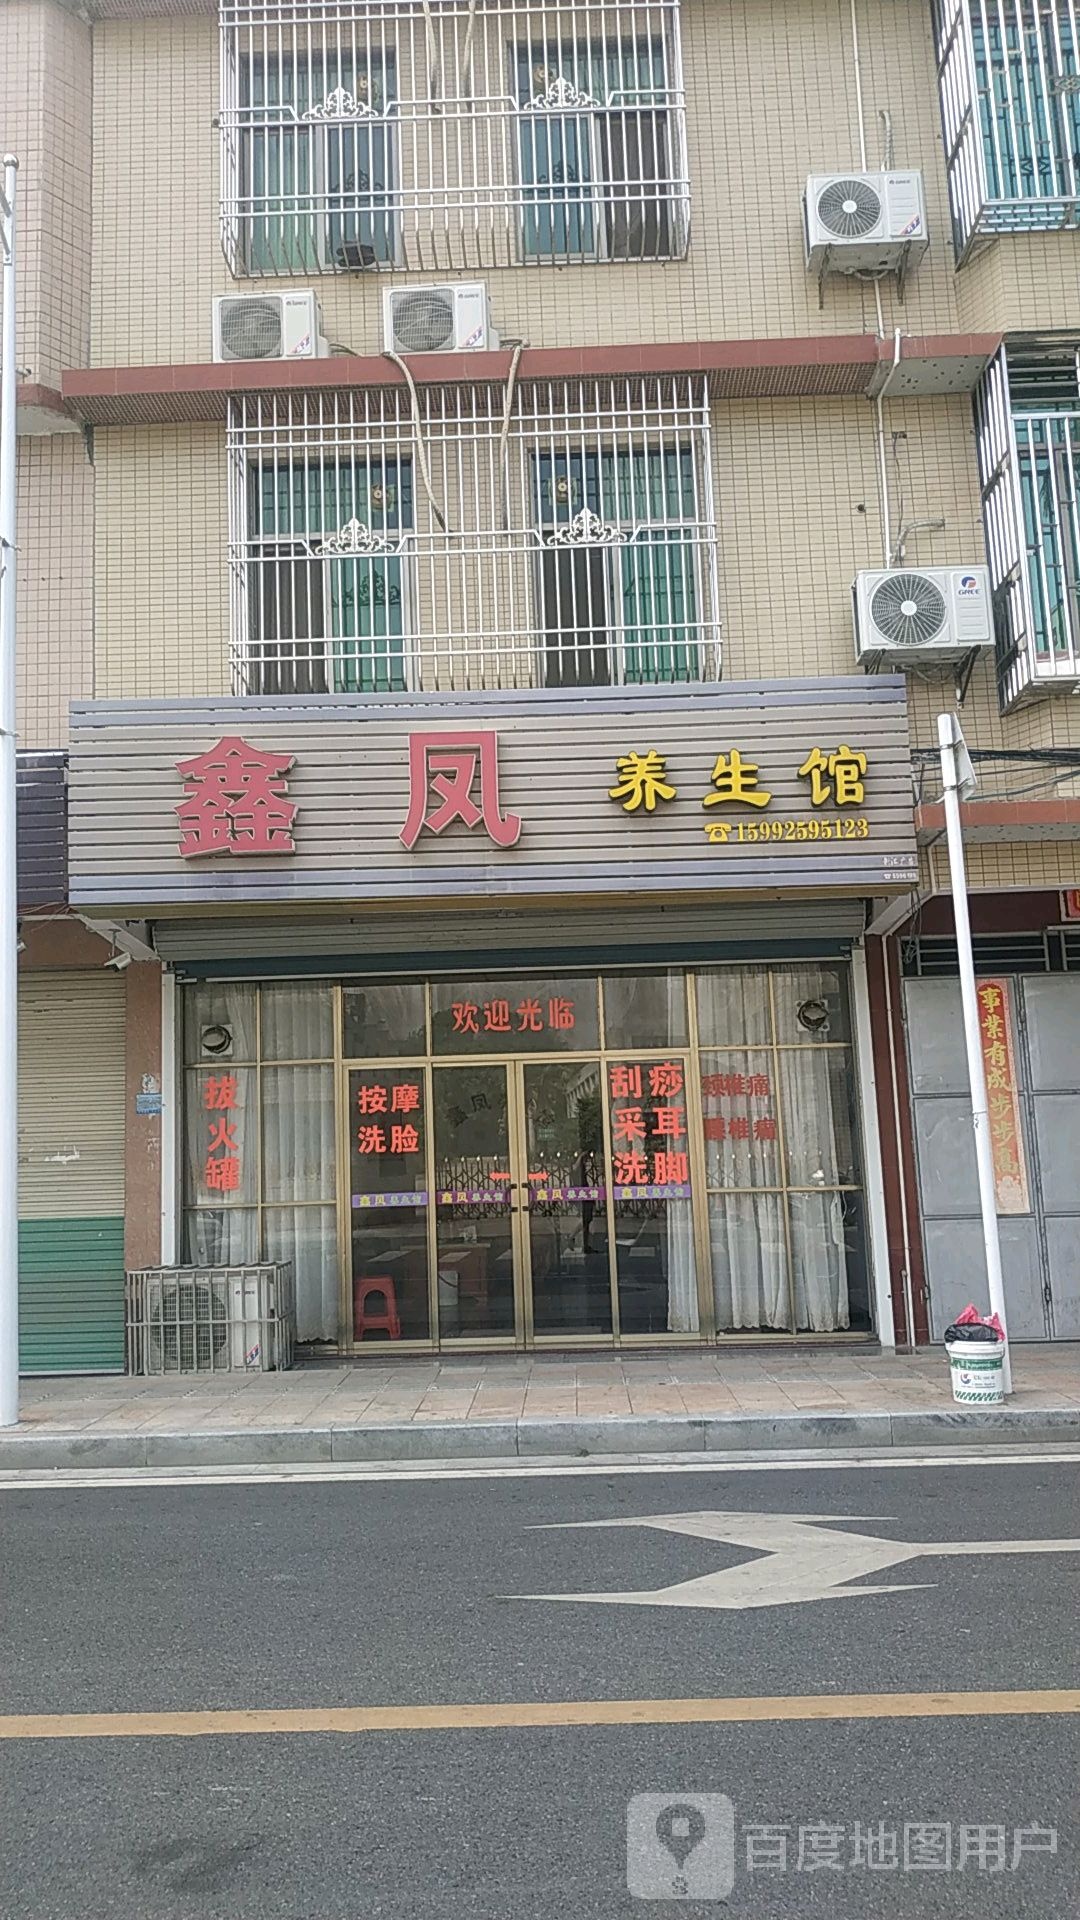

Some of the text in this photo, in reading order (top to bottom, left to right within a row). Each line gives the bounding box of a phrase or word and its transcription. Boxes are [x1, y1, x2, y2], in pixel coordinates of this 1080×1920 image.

[174, 731, 868, 858] 鑫凤 养生馆
[737, 818, 869, 843] 15992595123
[451, 996, 575, 1034] 欢迎光临
[609, 1062, 684, 1099] 刮痧
[702, 1073, 769, 1096] 颈椎痛
[358, 1084, 420, 1114] 按摩
[204, 1075, 241, 1192] 拔火罐
[358, 1124, 420, 1154] 洗脸
[612, 1106, 686, 1142] 采耳
[613, 1152, 688, 1185] 洗脚
